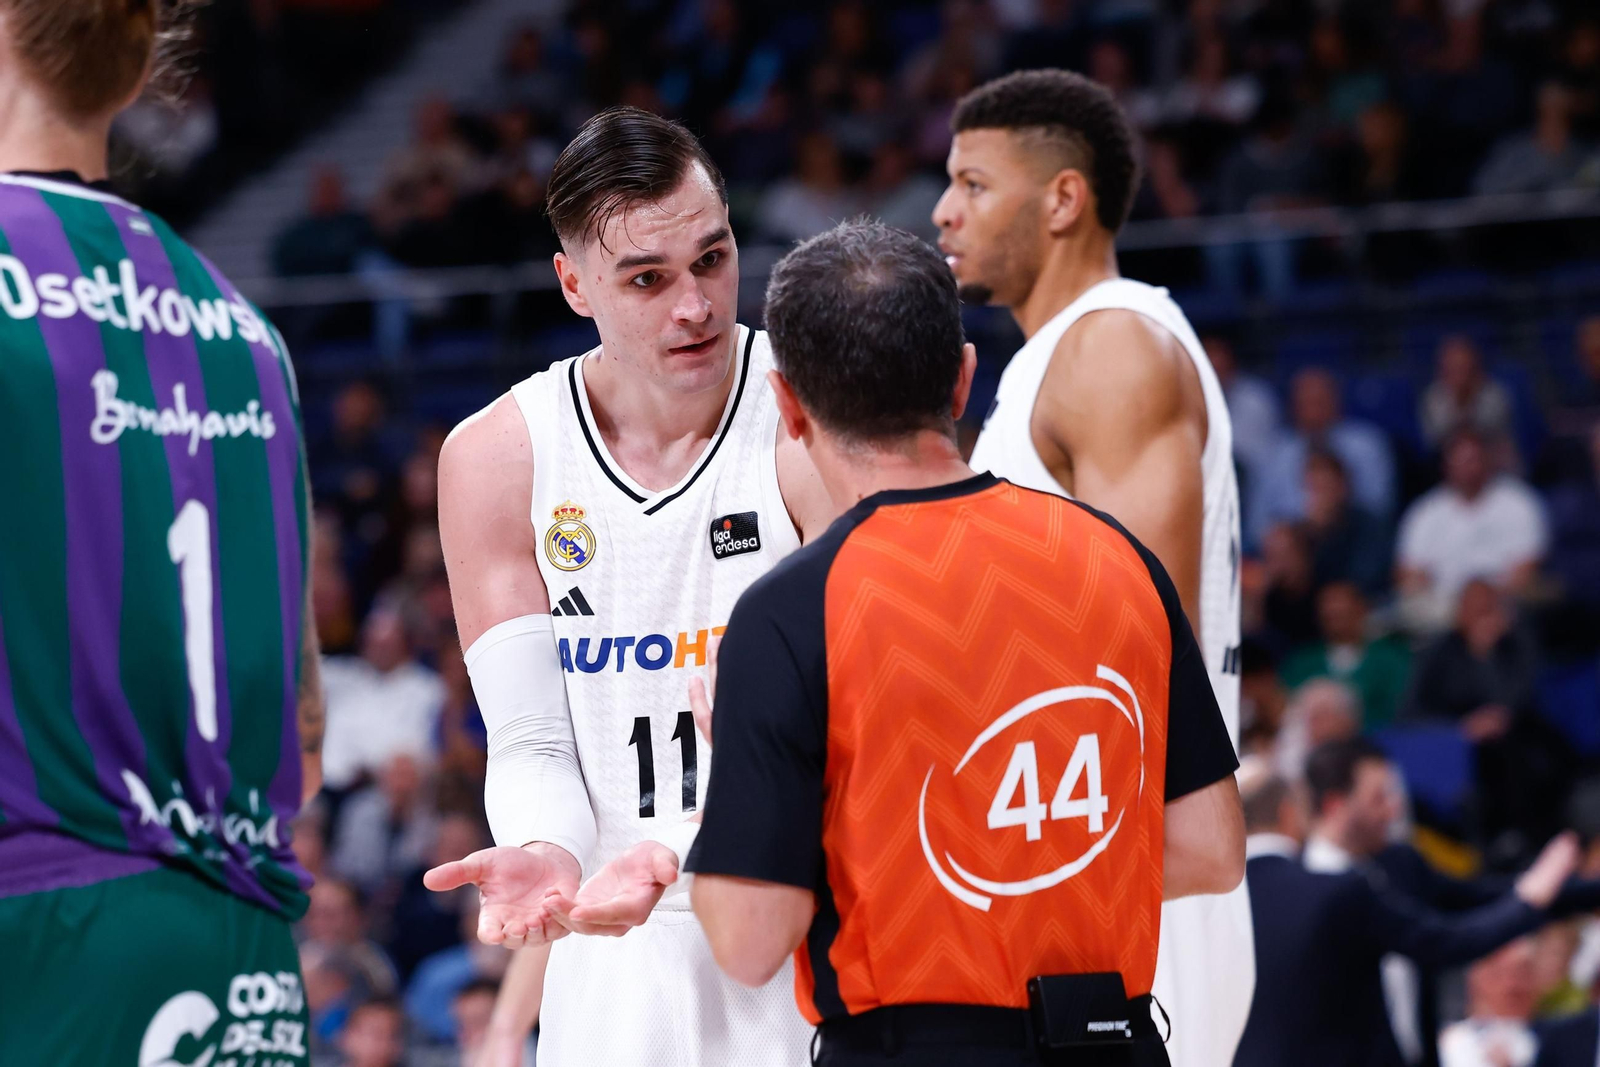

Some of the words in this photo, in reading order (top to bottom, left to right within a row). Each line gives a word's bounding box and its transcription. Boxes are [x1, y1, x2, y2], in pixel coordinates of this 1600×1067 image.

[713, 530, 731, 544] liga
[715, 537, 758, 554] endesa
[167, 499, 218, 742] 1
[559, 626, 728, 673] AUTOH
[628, 711, 697, 818] 11
[987, 733, 1108, 842] 44
